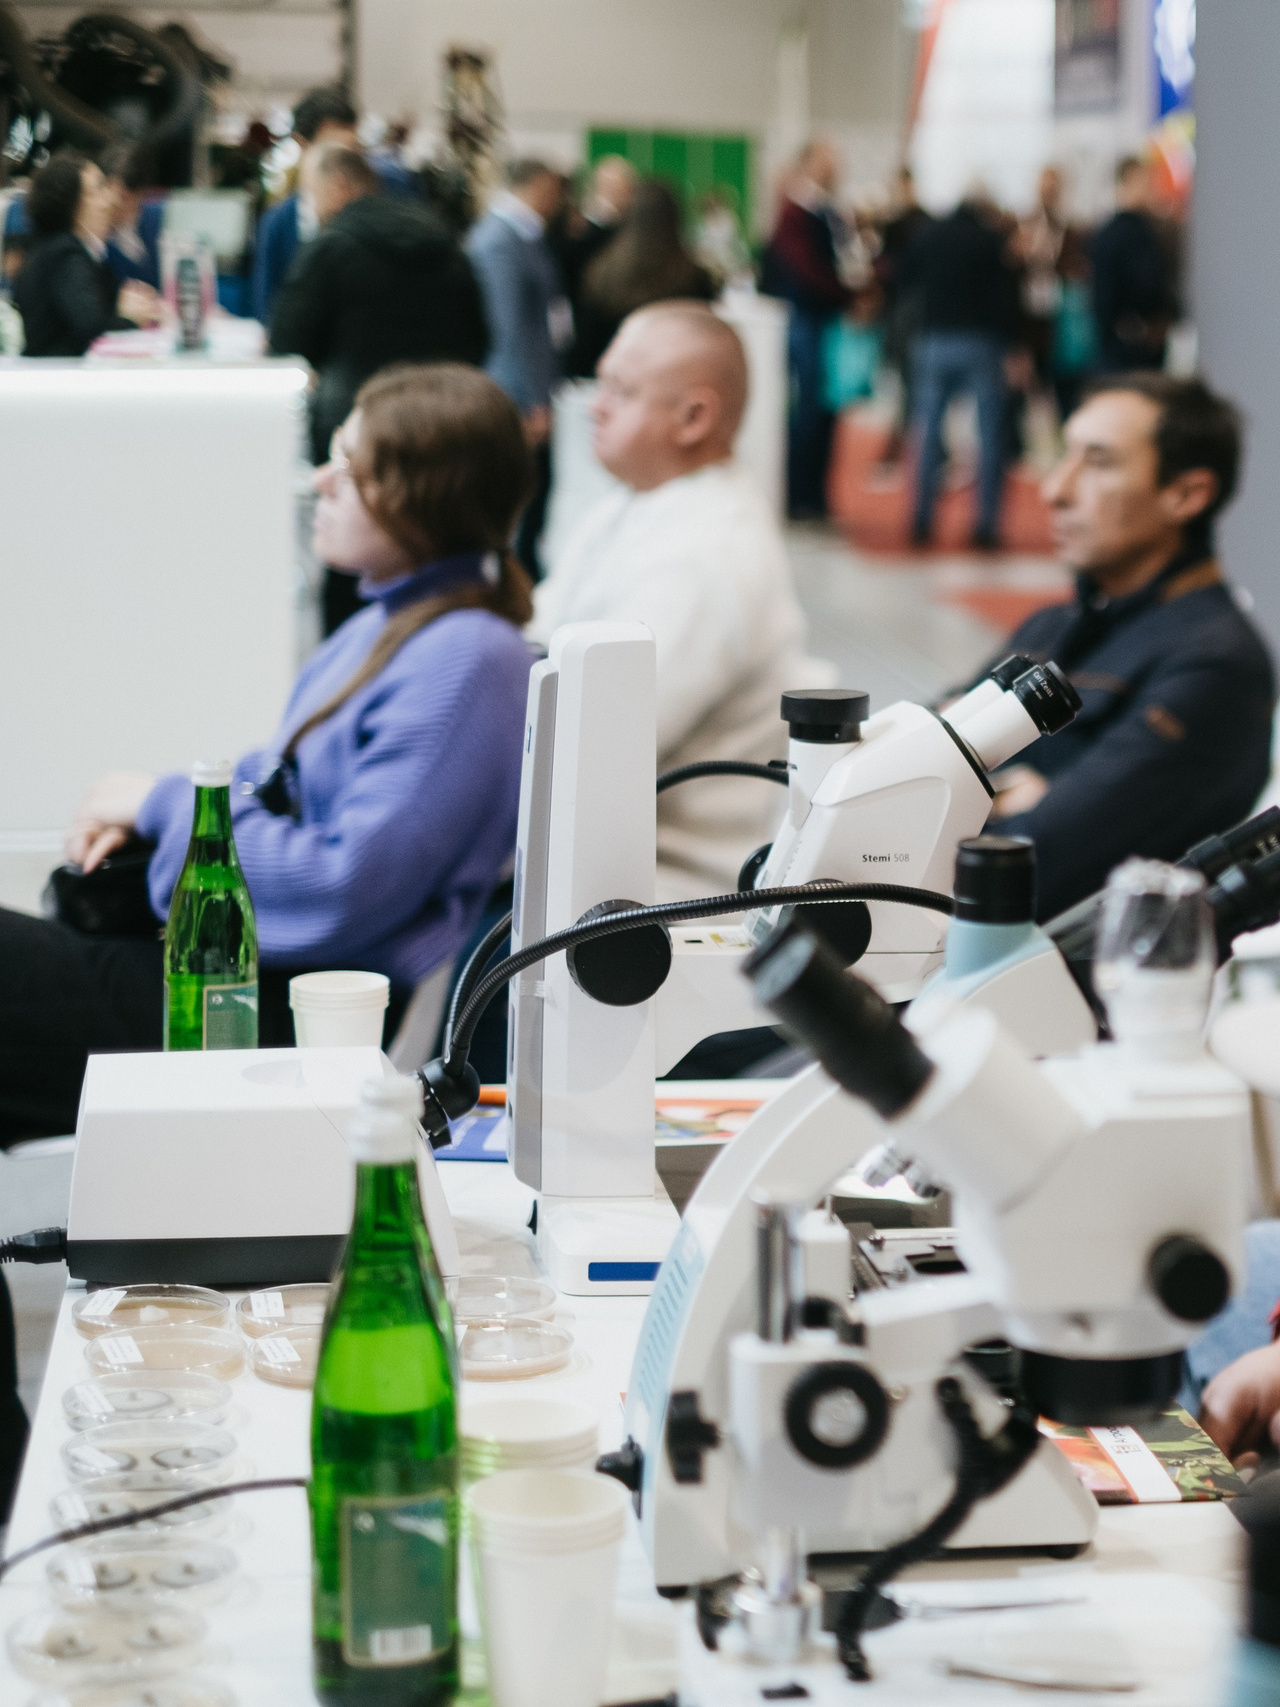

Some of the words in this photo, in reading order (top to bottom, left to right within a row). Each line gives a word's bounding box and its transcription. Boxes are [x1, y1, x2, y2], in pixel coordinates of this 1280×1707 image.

[1033, 671, 1045, 683] Carl
[1040, 680, 1054, 698] Zeiss
[862, 853, 891, 863] Stemi
[893, 853, 910, 863] 508
